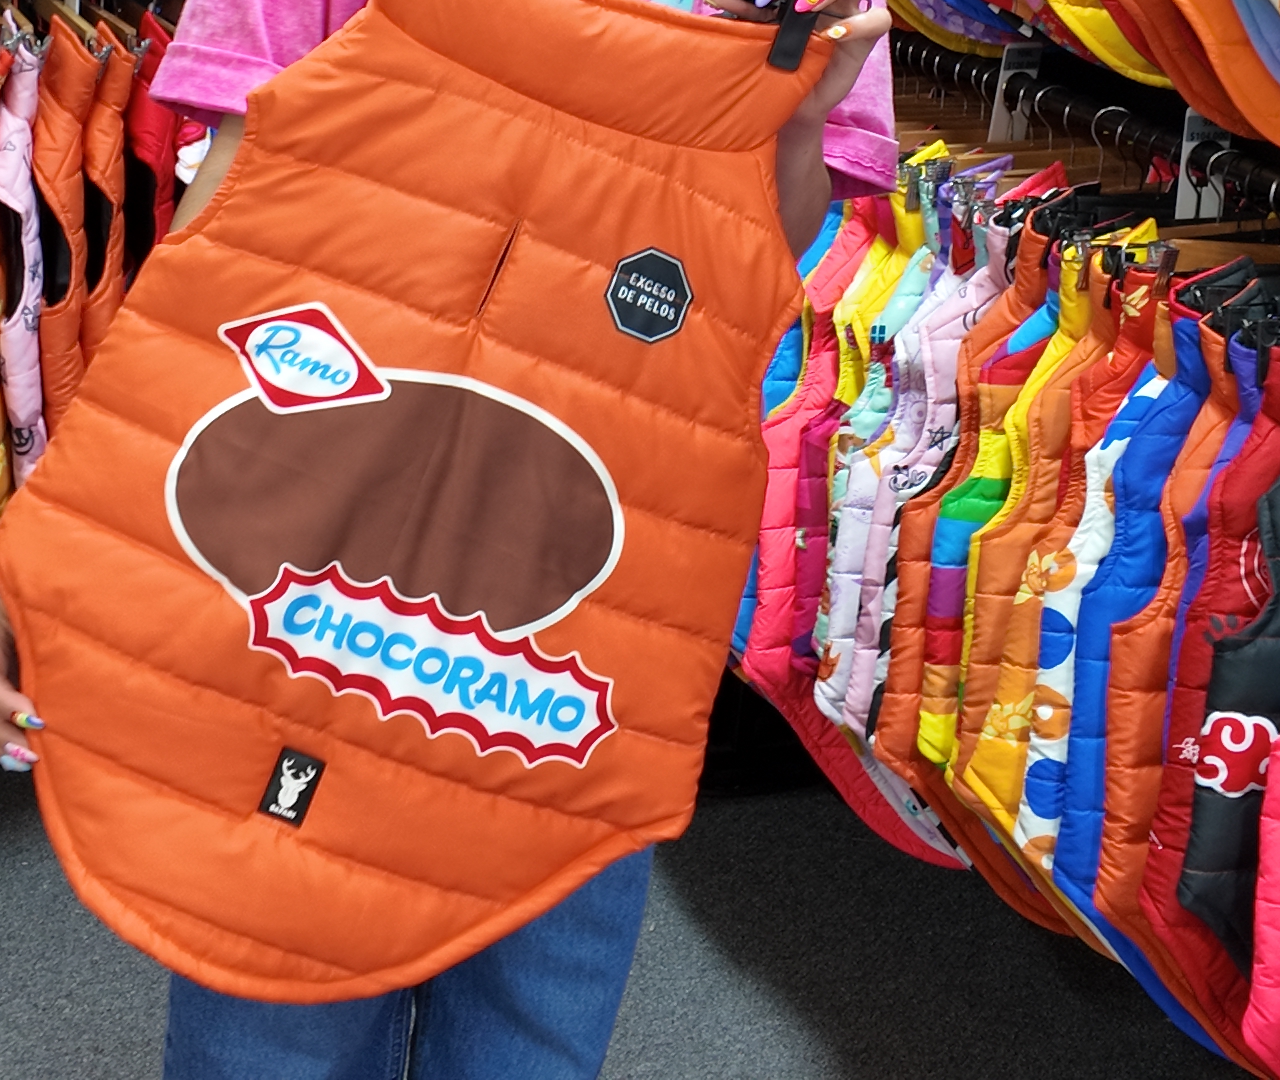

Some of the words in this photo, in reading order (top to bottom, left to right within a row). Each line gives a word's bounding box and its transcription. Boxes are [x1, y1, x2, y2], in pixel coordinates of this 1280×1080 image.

[617, 285, 637, 303] DE
[636, 294, 676, 321] PELOS
[629, 272, 676, 302] EXCESO
[255, 325, 350, 386] Ramo
[282, 593, 586, 732] CHOCORAMO
